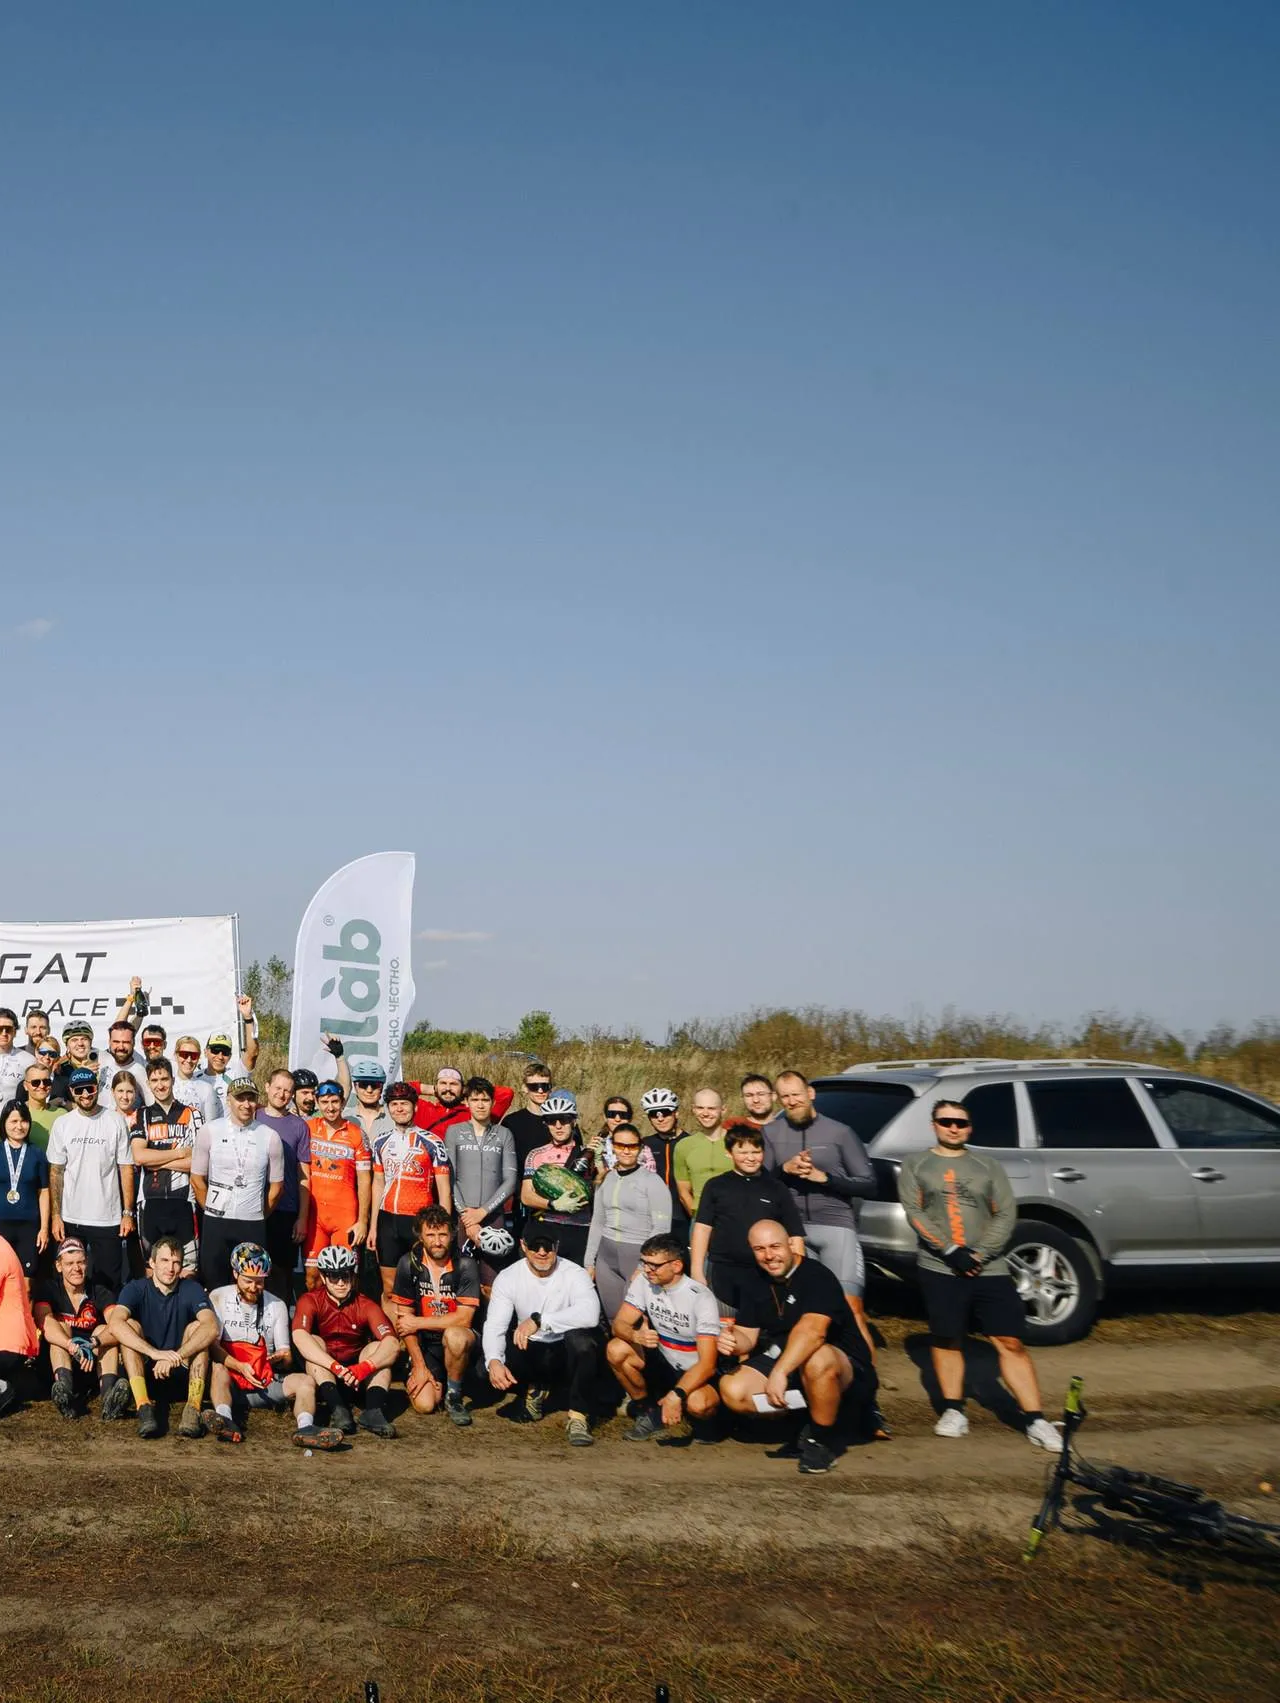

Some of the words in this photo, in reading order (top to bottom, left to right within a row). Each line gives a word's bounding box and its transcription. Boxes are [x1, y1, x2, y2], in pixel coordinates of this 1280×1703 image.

[389, 957, 400, 1012] ЧЕСТНО.
[22, 998, 109, 1017] RACE
[70, 1137, 107, 1145] FREGAT
[460, 1144, 501, 1153] FREGAT
[211, 1190, 220, 1204] 7
